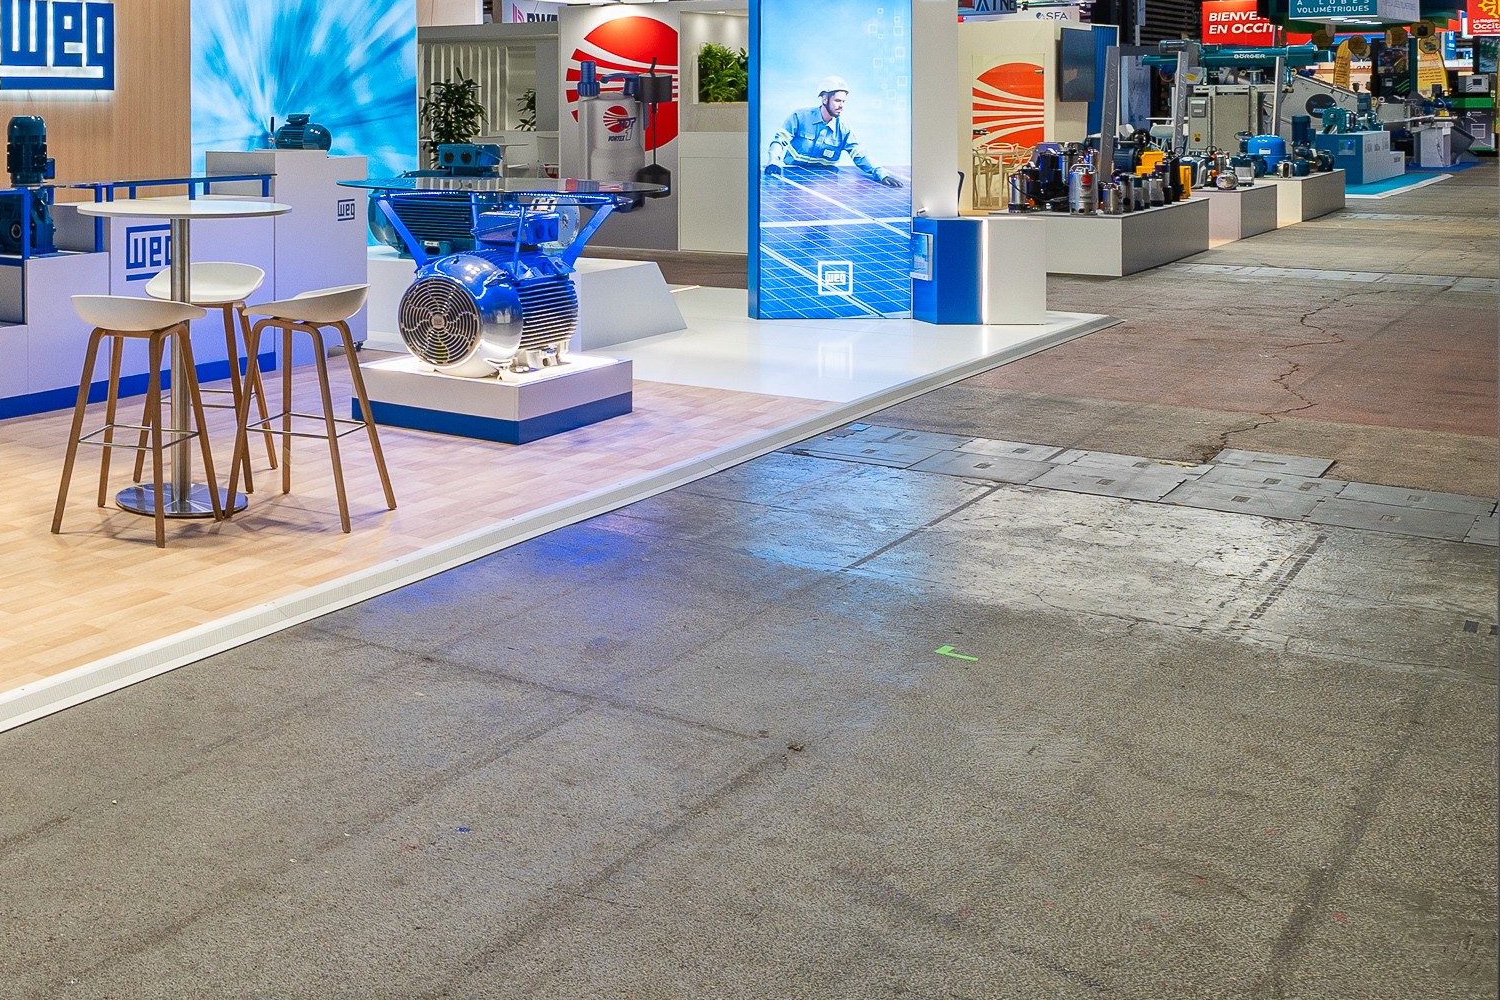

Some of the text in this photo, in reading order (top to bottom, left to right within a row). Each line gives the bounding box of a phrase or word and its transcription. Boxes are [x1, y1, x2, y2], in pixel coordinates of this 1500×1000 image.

[1296, 3, 1370, 14] VOLUMÉTRIQUES
[1046, 11, 1068, 21] SFA
[1208, 25, 1228, 34] EN
